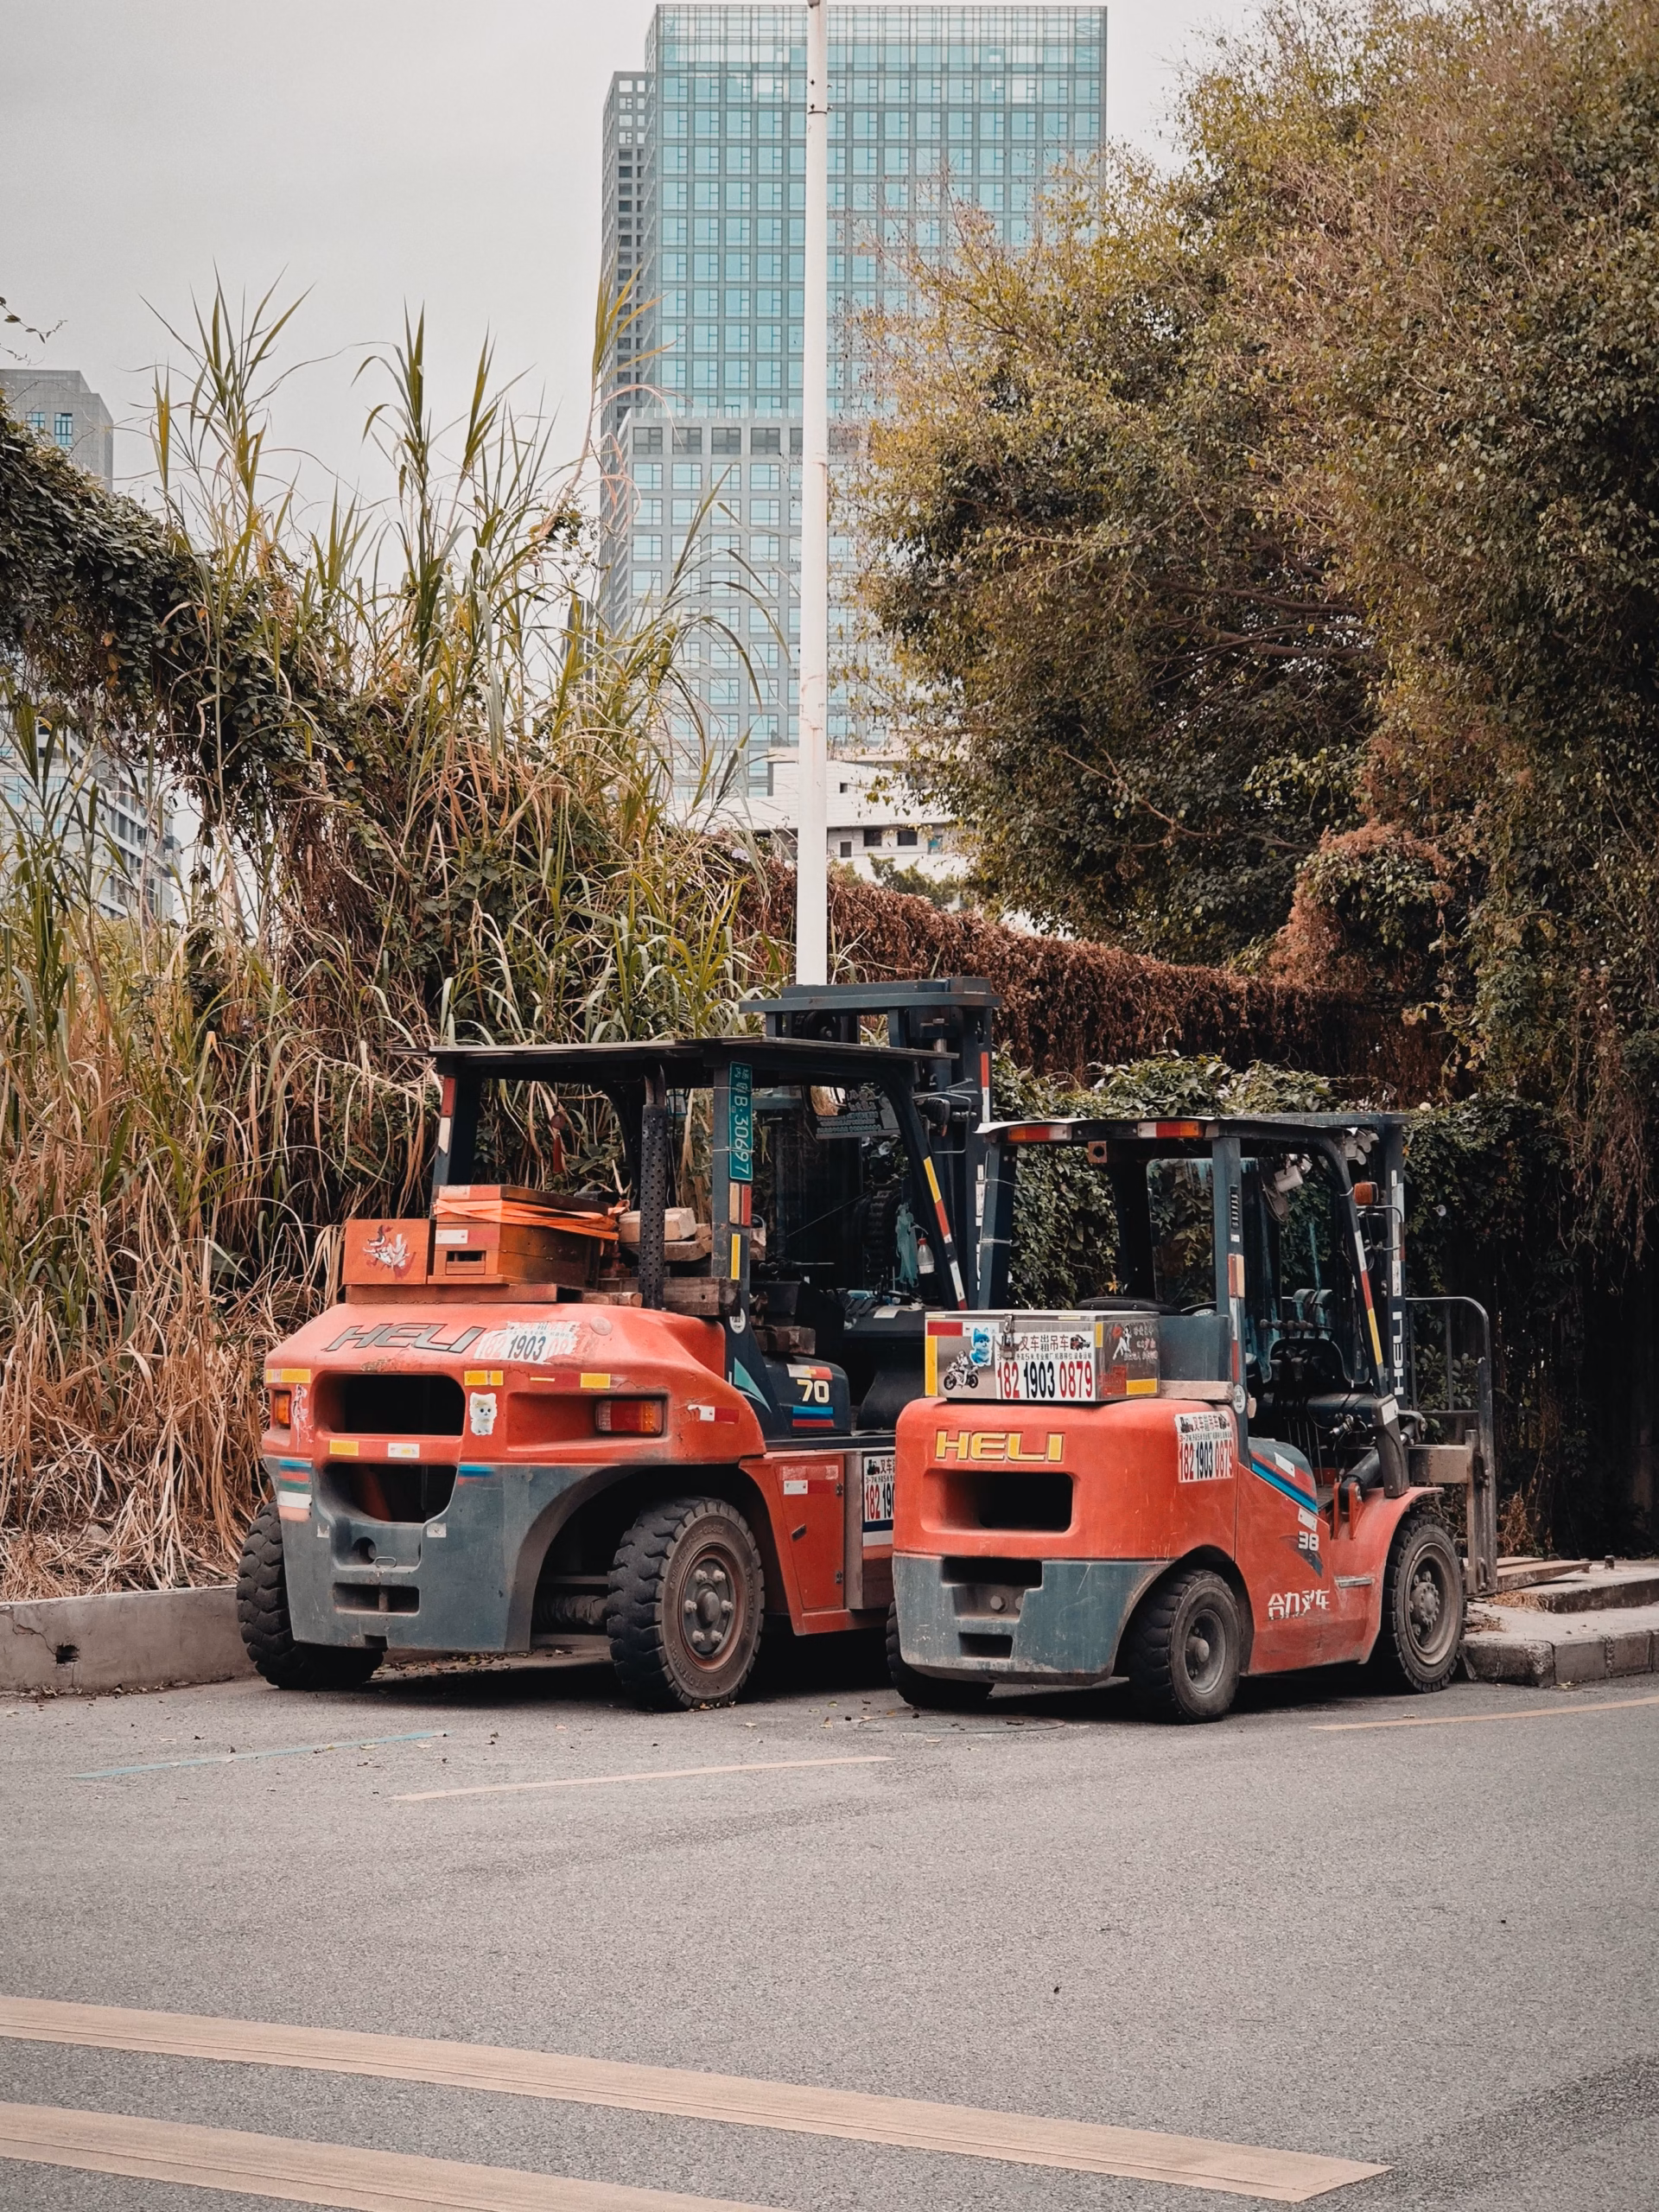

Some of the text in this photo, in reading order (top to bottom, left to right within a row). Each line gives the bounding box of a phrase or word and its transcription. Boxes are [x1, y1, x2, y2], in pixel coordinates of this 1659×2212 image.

[322, 1322, 487, 1354] HELI
[507, 1335, 546, 1361] 1903
[1392, 1311, 1404, 1395] HELI
[797, 1379, 830, 1403] 70
[997, 1362, 1020, 1399] 182
[1024, 1361, 1055, 1399] 1903
[1059, 1361, 1092, 1398] 0879
[936, 1429, 1065, 1462] HELI
[1179, 1440, 1233, 1481] 182 1903 0879
[866, 1484, 880, 1521] 182
[1298, 1530, 1319, 1551] 38
